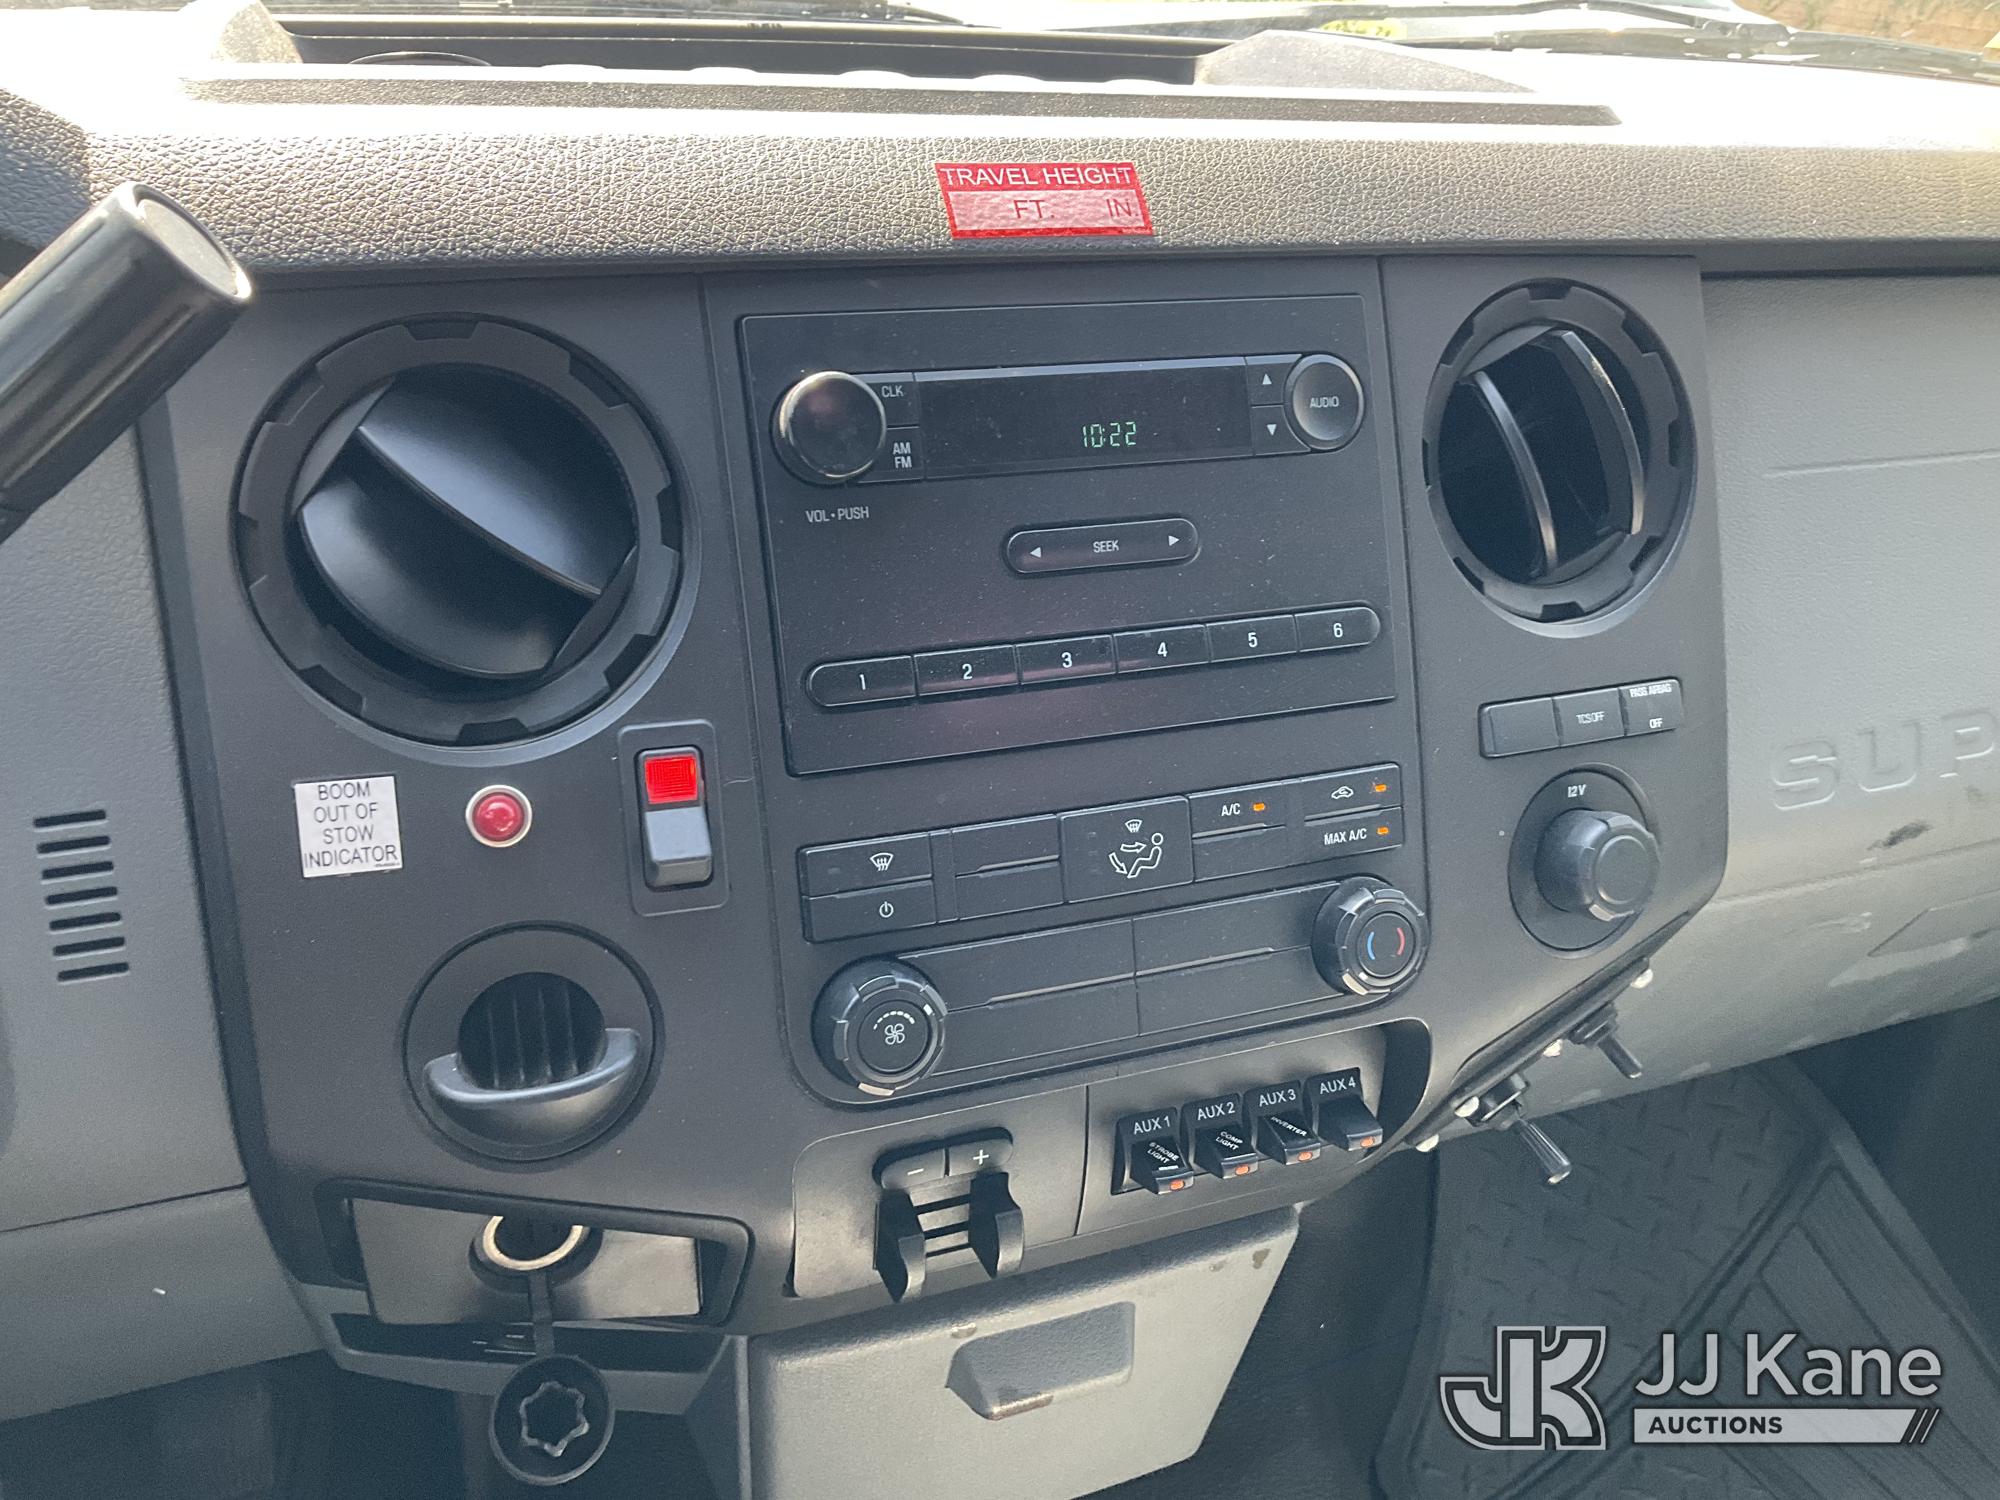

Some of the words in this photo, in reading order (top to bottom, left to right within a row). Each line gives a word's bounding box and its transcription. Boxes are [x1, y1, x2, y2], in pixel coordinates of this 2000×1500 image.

[940, 168, 1038, 186] TRAVEL
[1042, 167, 1132, 185] HEIGHT
[881, 385, 904, 398] CLK
[1309, 396, 1340, 409] AUDIO
[1082, 421, 1137, 448] 10:22
[893, 442, 911, 455] AM
[894, 456, 912, 469] FM
[1093, 539, 1120, 553] SEEK
[859, 673, 866, 690] 1
[962, 663, 973, 680] 2
[1061, 651, 1073, 668] 3
[1157, 641, 1168, 658] 4
[1247, 632, 1258, 648] 5
[1333, 622, 1344, 638] 6
[1649, 717, 1663, 729] OFF
[317, 781, 371, 800] BOOM
[1567, 784, 1587, 798] 12V
[313, 804, 350, 823] OUT
[355, 801, 379, 820] OF
[1221, 803, 1241, 817] A/C
[322, 823, 375, 845] STOW
[1323, 831, 1348, 846] MAX
[1349, 828, 1368, 842] A/C
[303, 844, 399, 868] INDICATOR
[1319, 1078, 1348, 1095] AUX
[1348, 1076, 1356, 1088] 4
[1258, 1091, 1288, 1107] AUX
[1287, 1088, 1297, 1101] 3
[1197, 1104, 1227, 1121] AUX
[1226, 1101, 1236, 1115] 2
[1133, 1117, 1162, 1135] AUX
[1163, 1116, 1171, 1128] 1
[1270, 1116, 1308, 1137] INVERTER
[1215, 1136, 1239, 1151] LIGHT
[1220, 1131, 1243, 1144] COMP
[1147, 1149, 1171, 1164] LIGHT
[1149, 1141, 1180, 1162] STROBE
